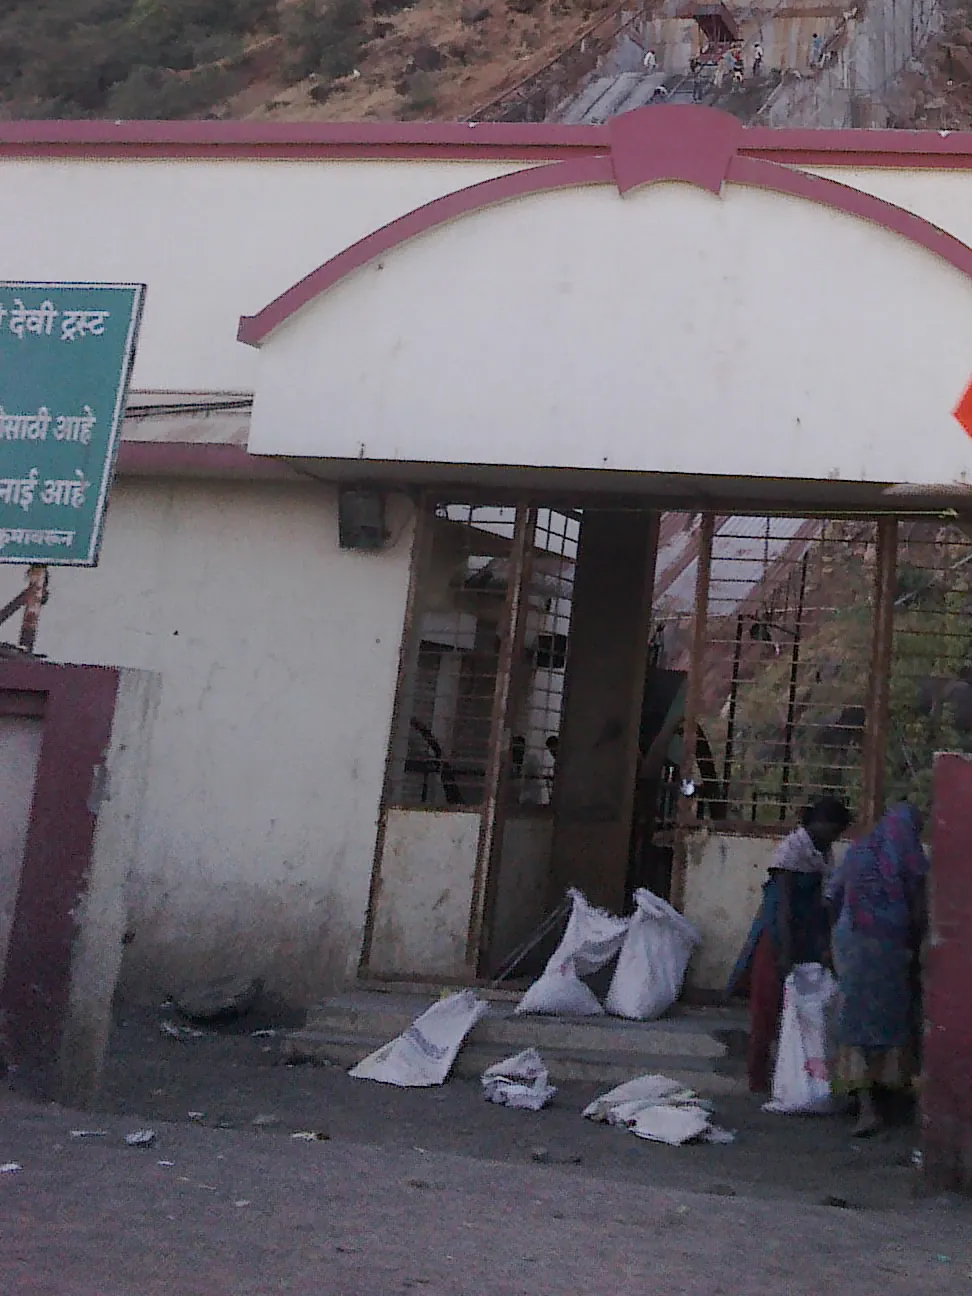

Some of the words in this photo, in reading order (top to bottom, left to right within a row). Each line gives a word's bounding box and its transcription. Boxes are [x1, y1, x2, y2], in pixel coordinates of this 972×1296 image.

[9, 298, 57, 339] देवी
[60, 310, 110, 340] ट्रस्ट
[53, 405, 96, 445] आहे
[40, 469, 89, 508] आहे
